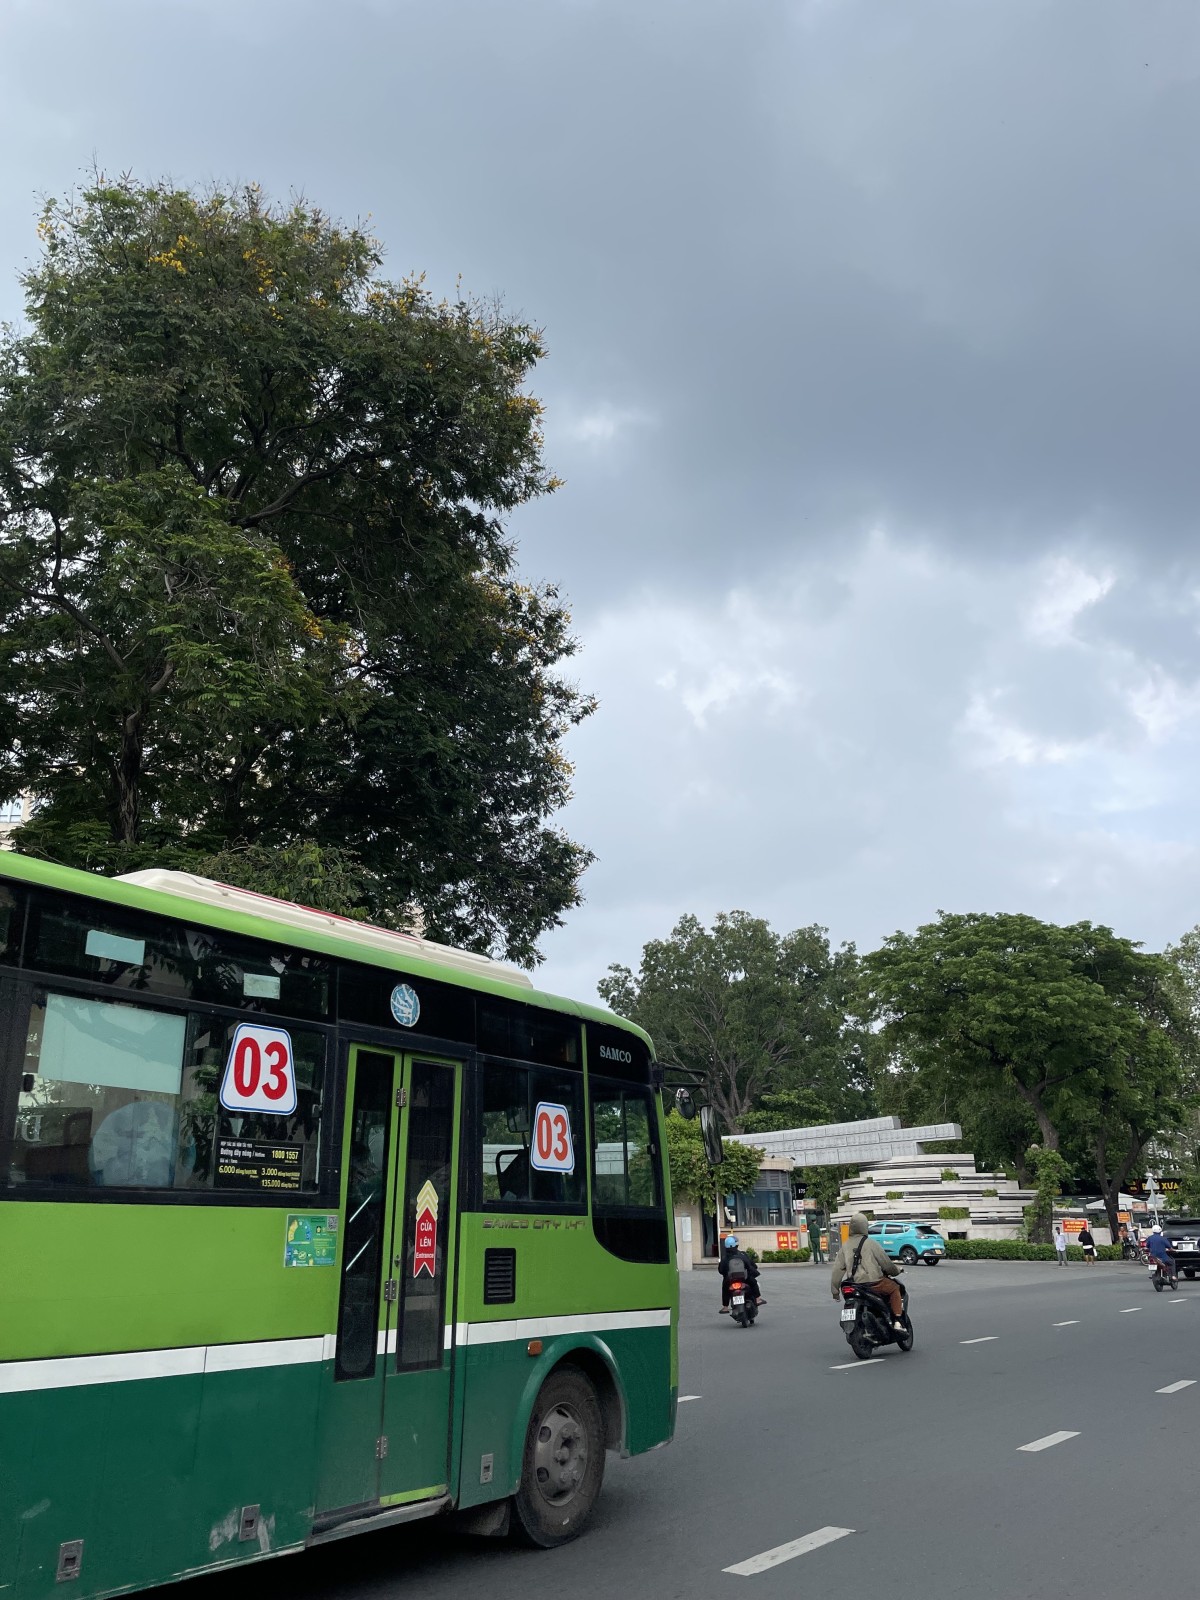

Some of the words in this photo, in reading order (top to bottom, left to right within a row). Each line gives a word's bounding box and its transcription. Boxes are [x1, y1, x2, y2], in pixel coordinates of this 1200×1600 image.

[599, 1045, 632, 1064] SAMCO
[234, 1036, 289, 1101] 03
[536, 1111, 569, 1162] 03
[286, 1151, 299, 1160] 1557
[420, 1219, 433, 1232] CỬA
[419, 1235, 432, 1247] LÊN
